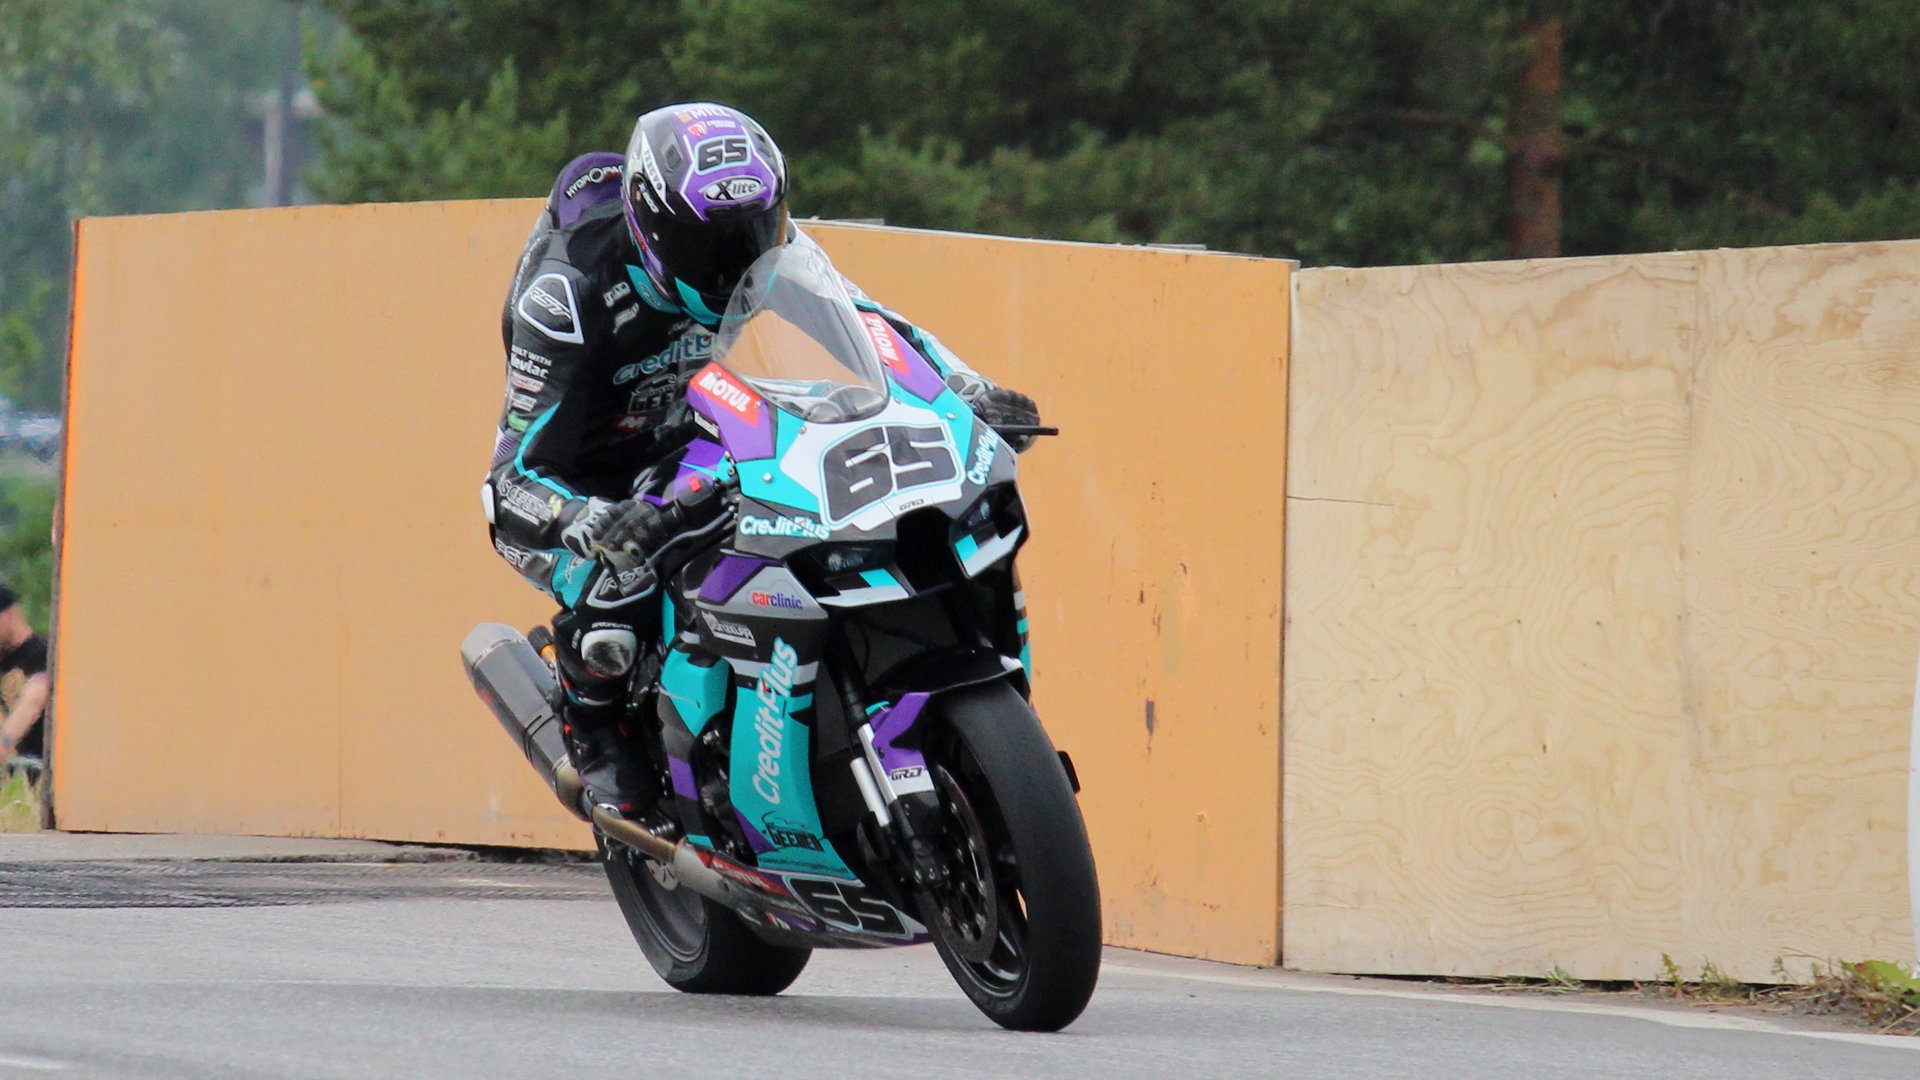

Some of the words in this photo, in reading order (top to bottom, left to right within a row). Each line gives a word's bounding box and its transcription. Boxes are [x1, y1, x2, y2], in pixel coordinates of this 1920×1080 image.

[697, 137, 749, 172] 65
[710, 180, 758, 201] X-lite
[867, 317, 899, 362] MOTUL
[699, 370, 752, 413] MOTUL
[822, 424, 960, 523] 65
[739, 514, 832, 540] CreditPlus
[751, 591, 803, 610] carclinic
[751, 636, 799, 805] CreditPlus
[788, 876, 909, 936] 65
